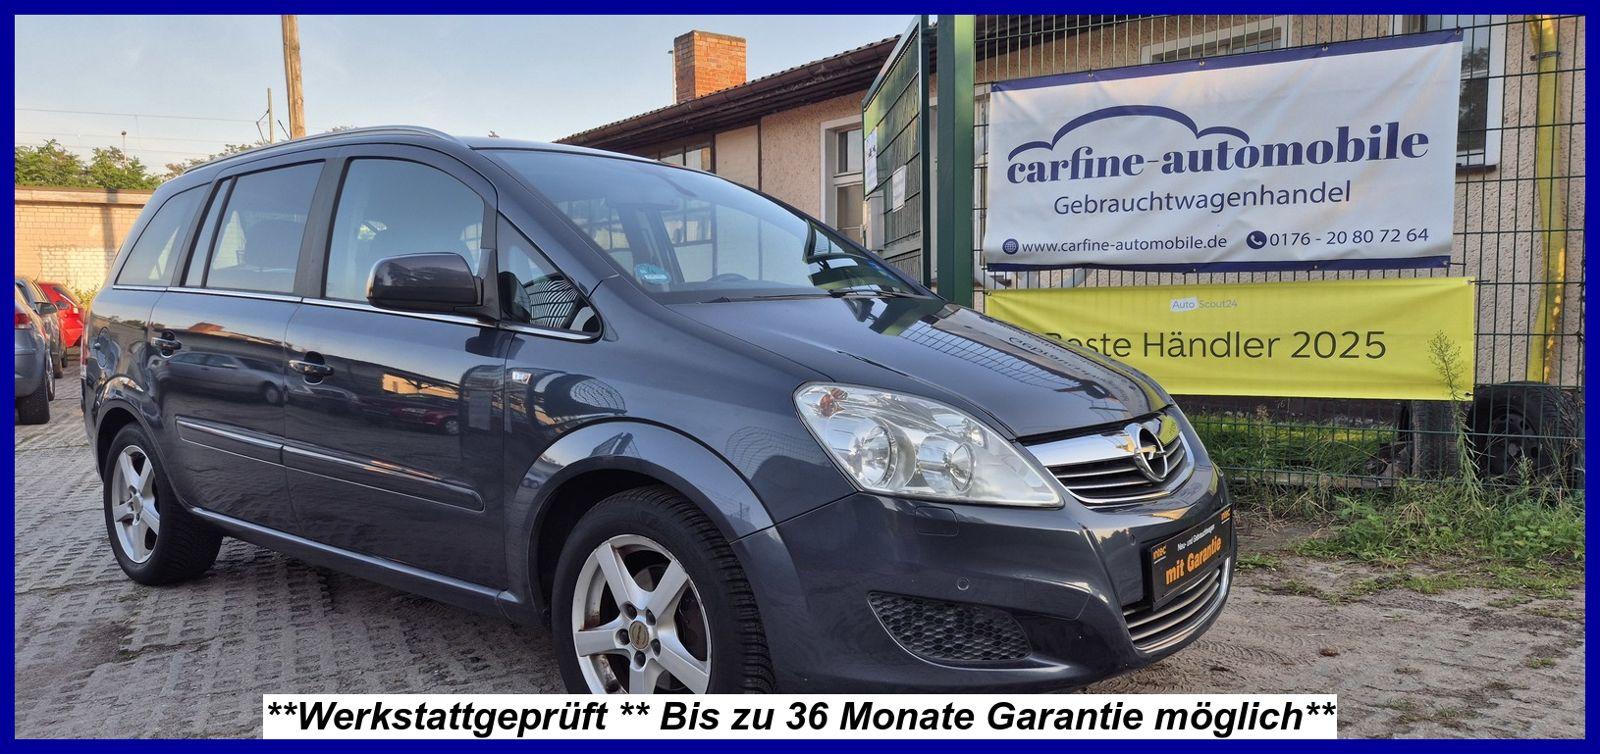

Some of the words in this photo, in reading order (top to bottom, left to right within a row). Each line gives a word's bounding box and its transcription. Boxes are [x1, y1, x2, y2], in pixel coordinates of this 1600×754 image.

[1007, 121, 1430, 184] carfine-automobile
[1054, 180, 1352, 215] Gebrauchtwagenhandel
[1022, 235, 1228, 252] www.carfine-automobile.de
[1269, 232, 1311, 247] 0176
[1326, 231, 1348, 245] 20
[1352, 229, 1374, 244] 80
[1380, 228, 1401, 243] 72
[1406, 228, 1429, 242] 64
[1172, 300, 1196, 309] Auto
[1199, 299, 1238, 309] Scout24
[1143, 331, 1281, 358] Händler
[1291, 331, 1387, 359] 2025
[1165, 559, 1185, 585] mit
[1187, 535, 1222, 572] Garantie
